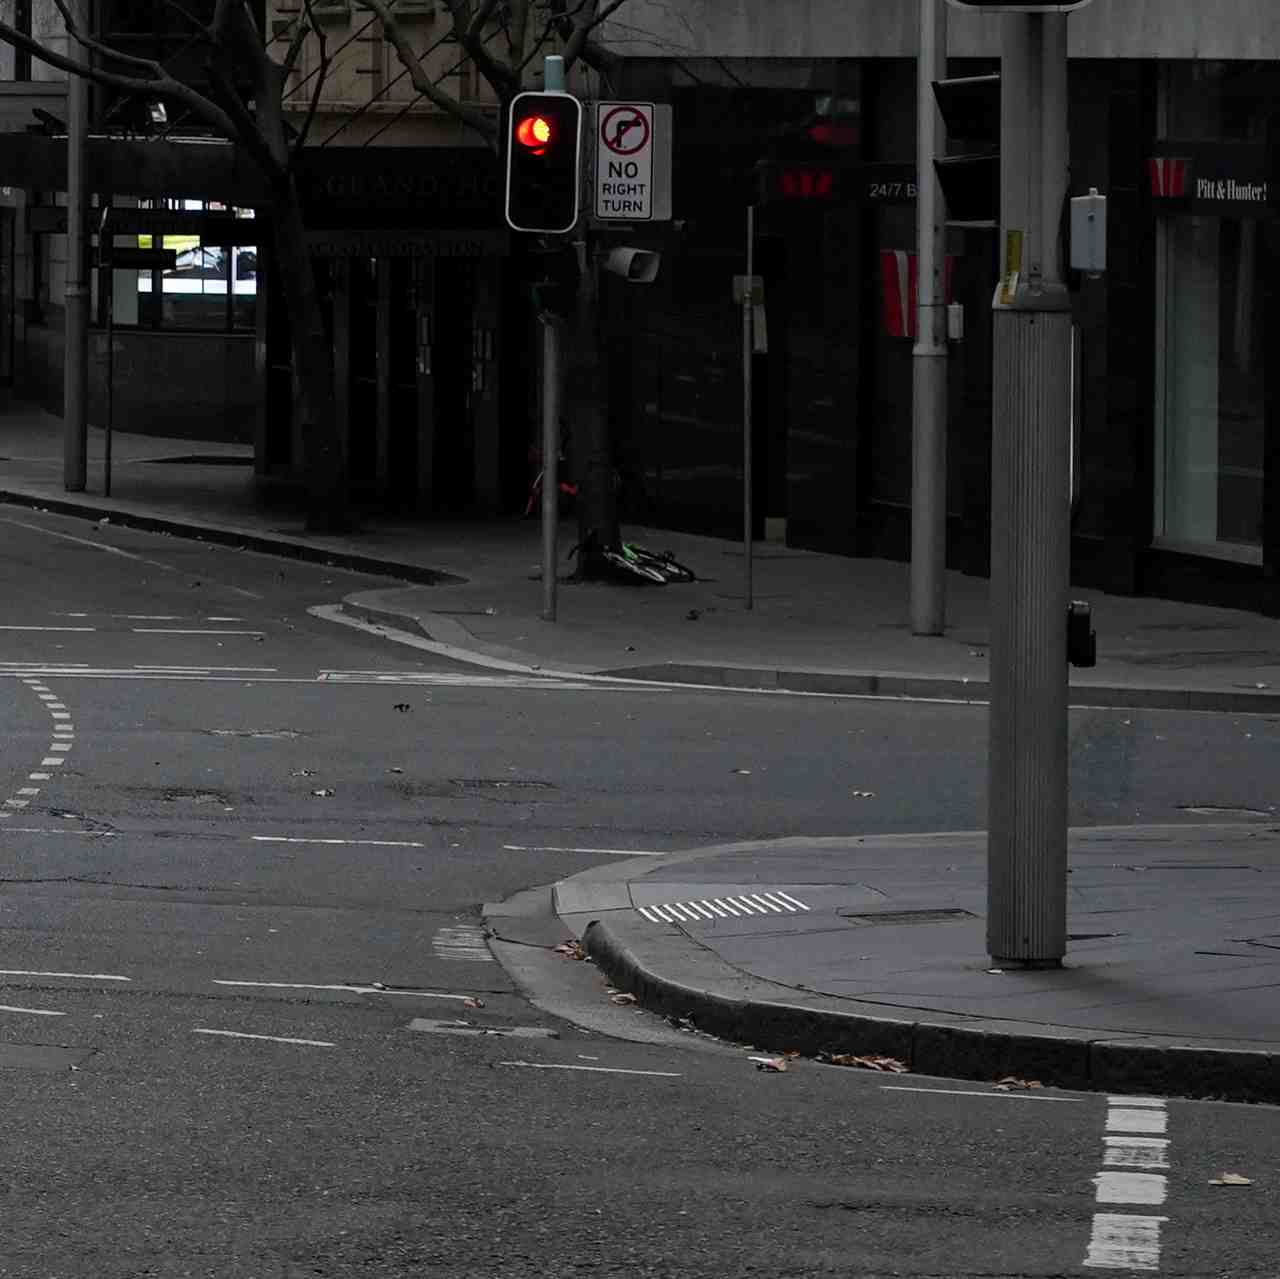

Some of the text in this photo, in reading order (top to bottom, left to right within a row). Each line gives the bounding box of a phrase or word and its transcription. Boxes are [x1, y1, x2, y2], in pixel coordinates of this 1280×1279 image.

[608, 161, 638, 178] NO
[602, 183, 646, 195] RIGHT
[869, 184, 903, 199] 24/7
[602, 199, 642, 212] TURN
